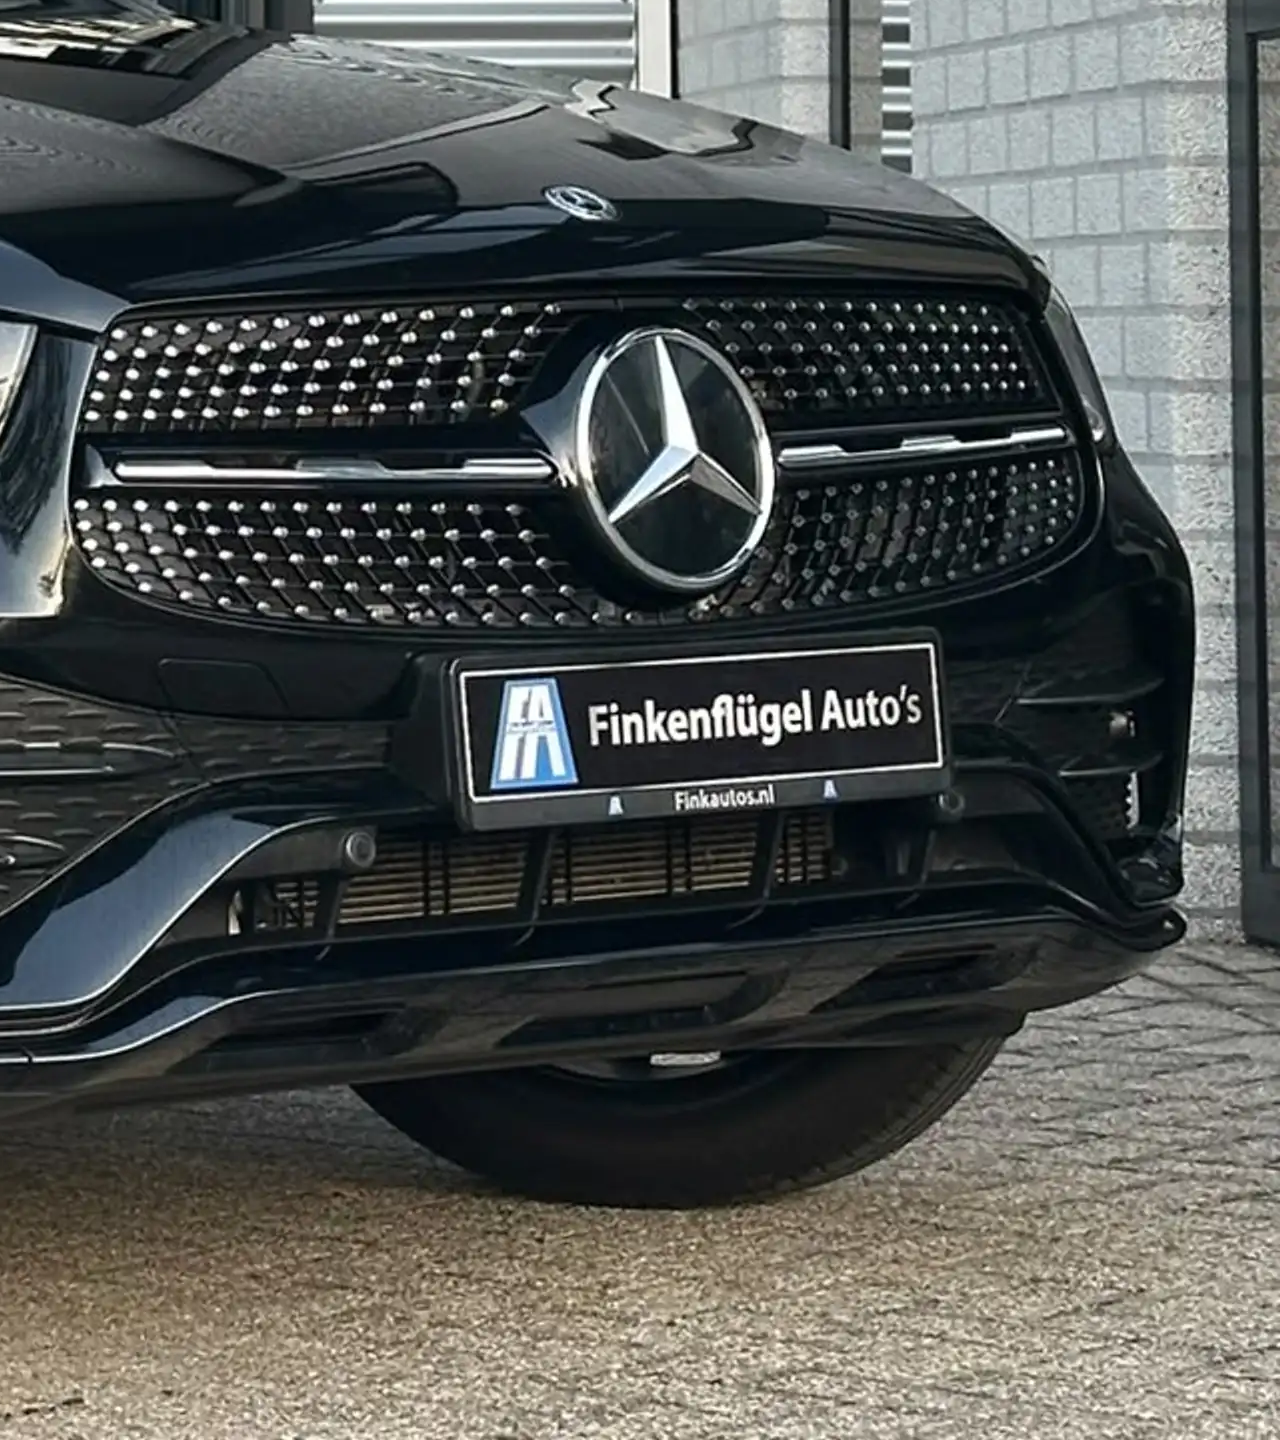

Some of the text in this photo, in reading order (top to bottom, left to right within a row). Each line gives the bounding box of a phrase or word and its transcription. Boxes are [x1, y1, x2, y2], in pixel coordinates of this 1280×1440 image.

[587, 684, 922, 748] Finkenflügel Auto's
[673, 783, 776, 812] Finkautos.nl
